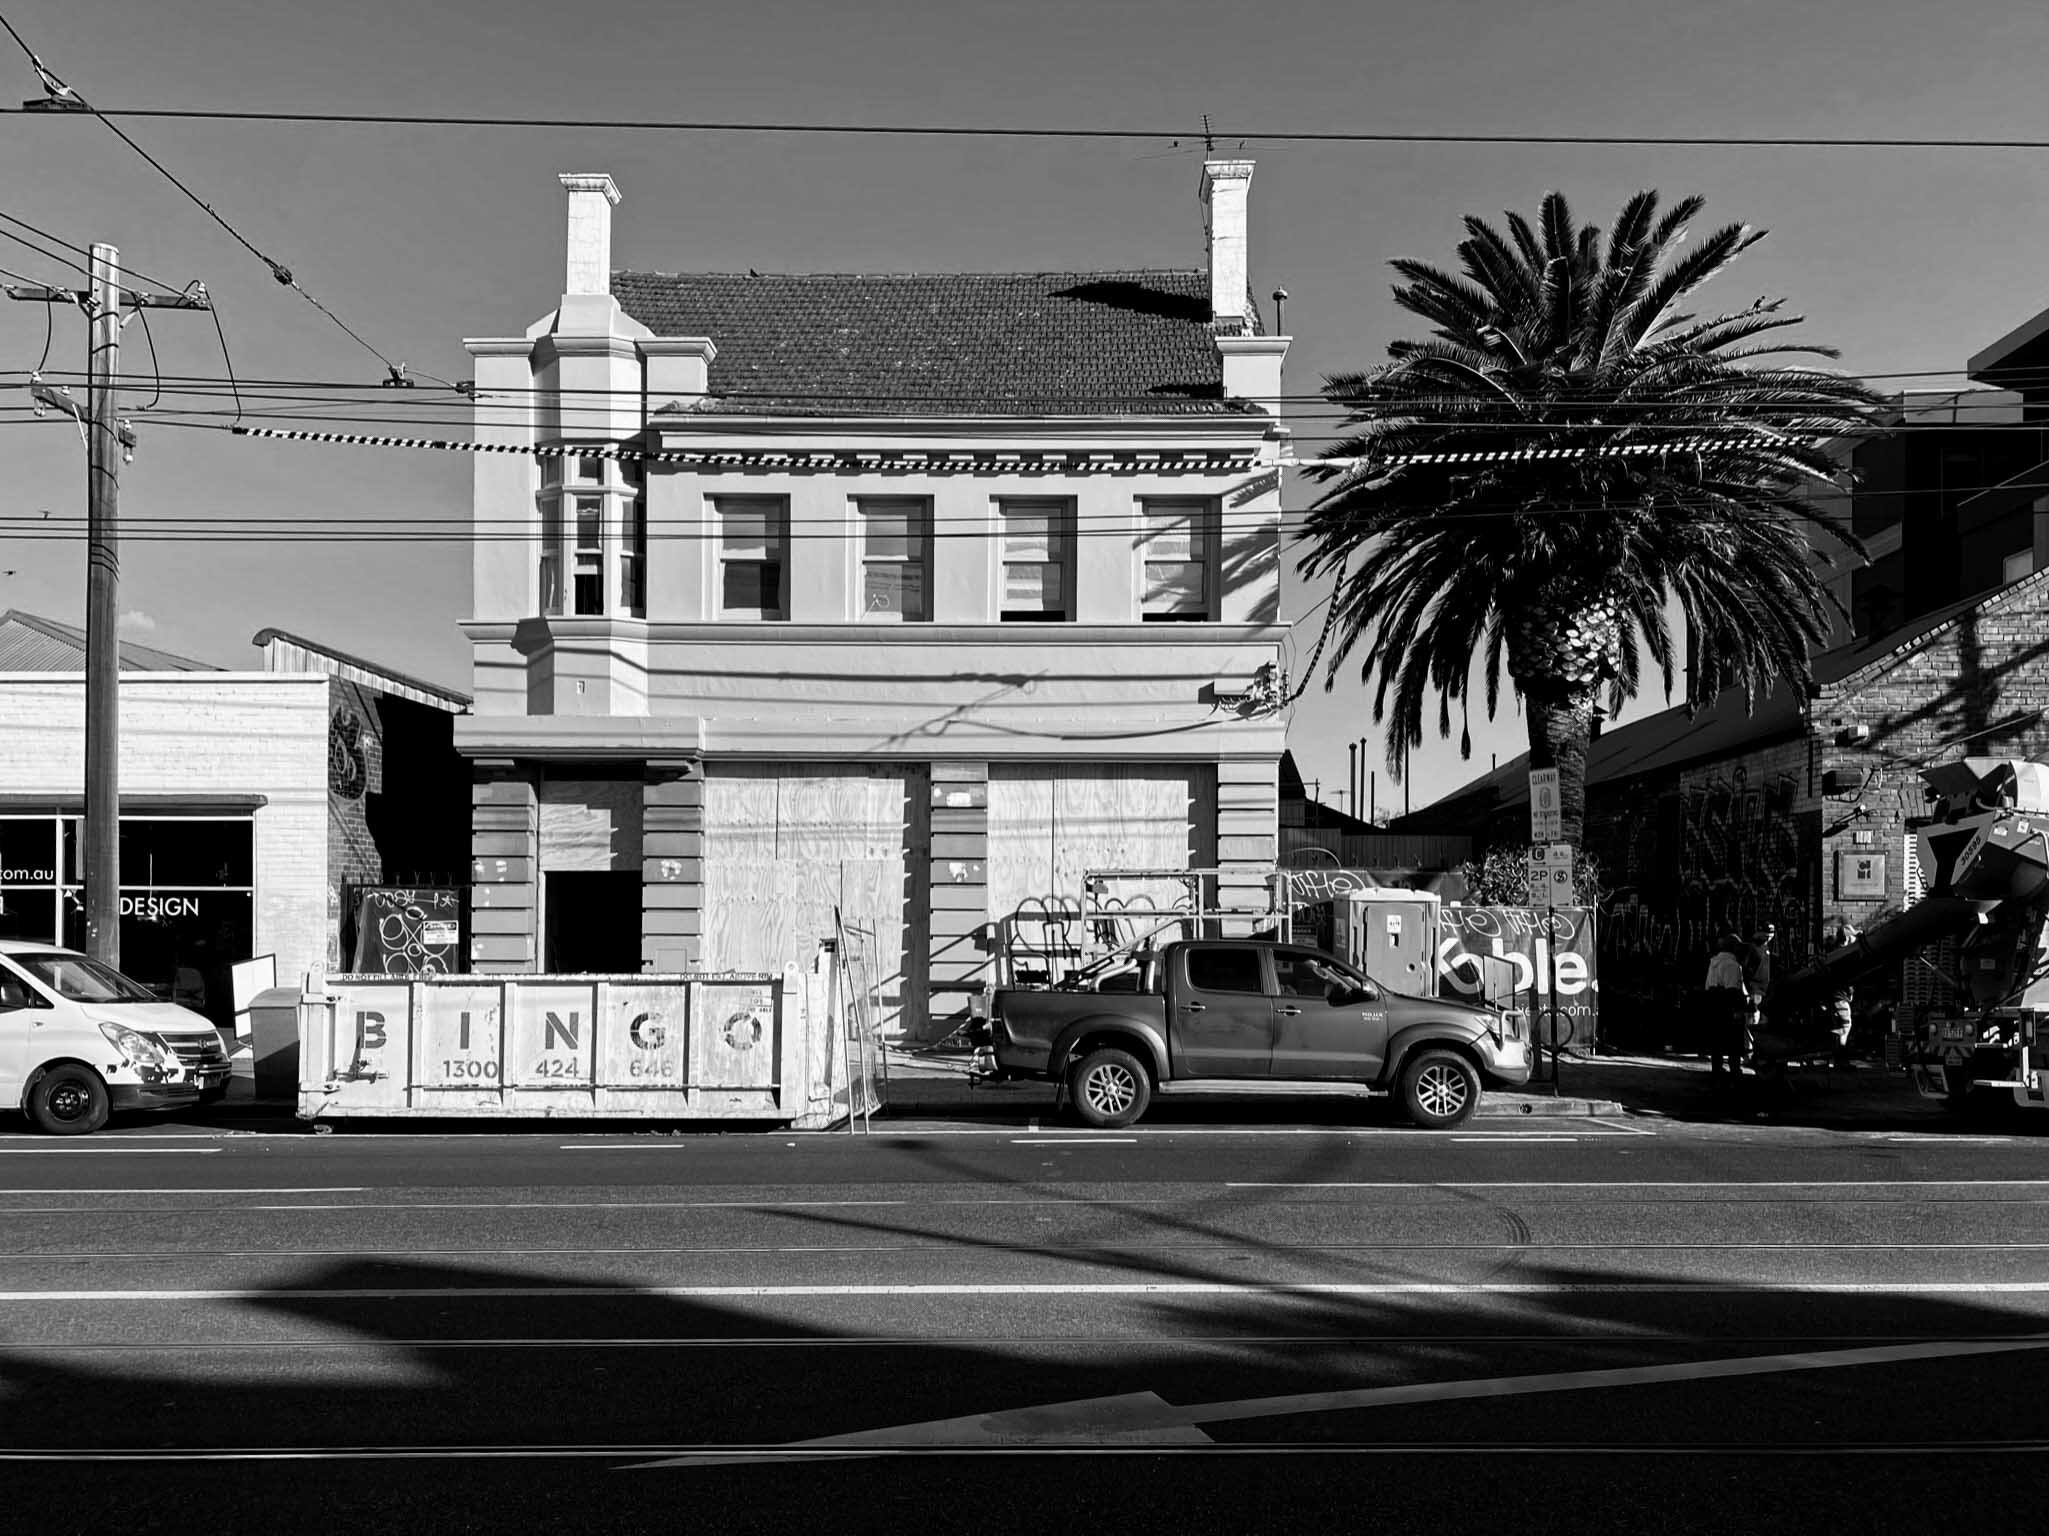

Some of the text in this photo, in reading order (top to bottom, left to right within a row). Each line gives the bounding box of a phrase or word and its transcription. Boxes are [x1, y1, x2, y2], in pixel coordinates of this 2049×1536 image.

[0, 869, 54, 880] om.au
[1530, 870, 1548, 881] 2P
[119, 897, 199, 916] DESIGN
[357, 1011, 762, 1050] BINGO
[443, 1057, 673, 1079] 1300 424 646
